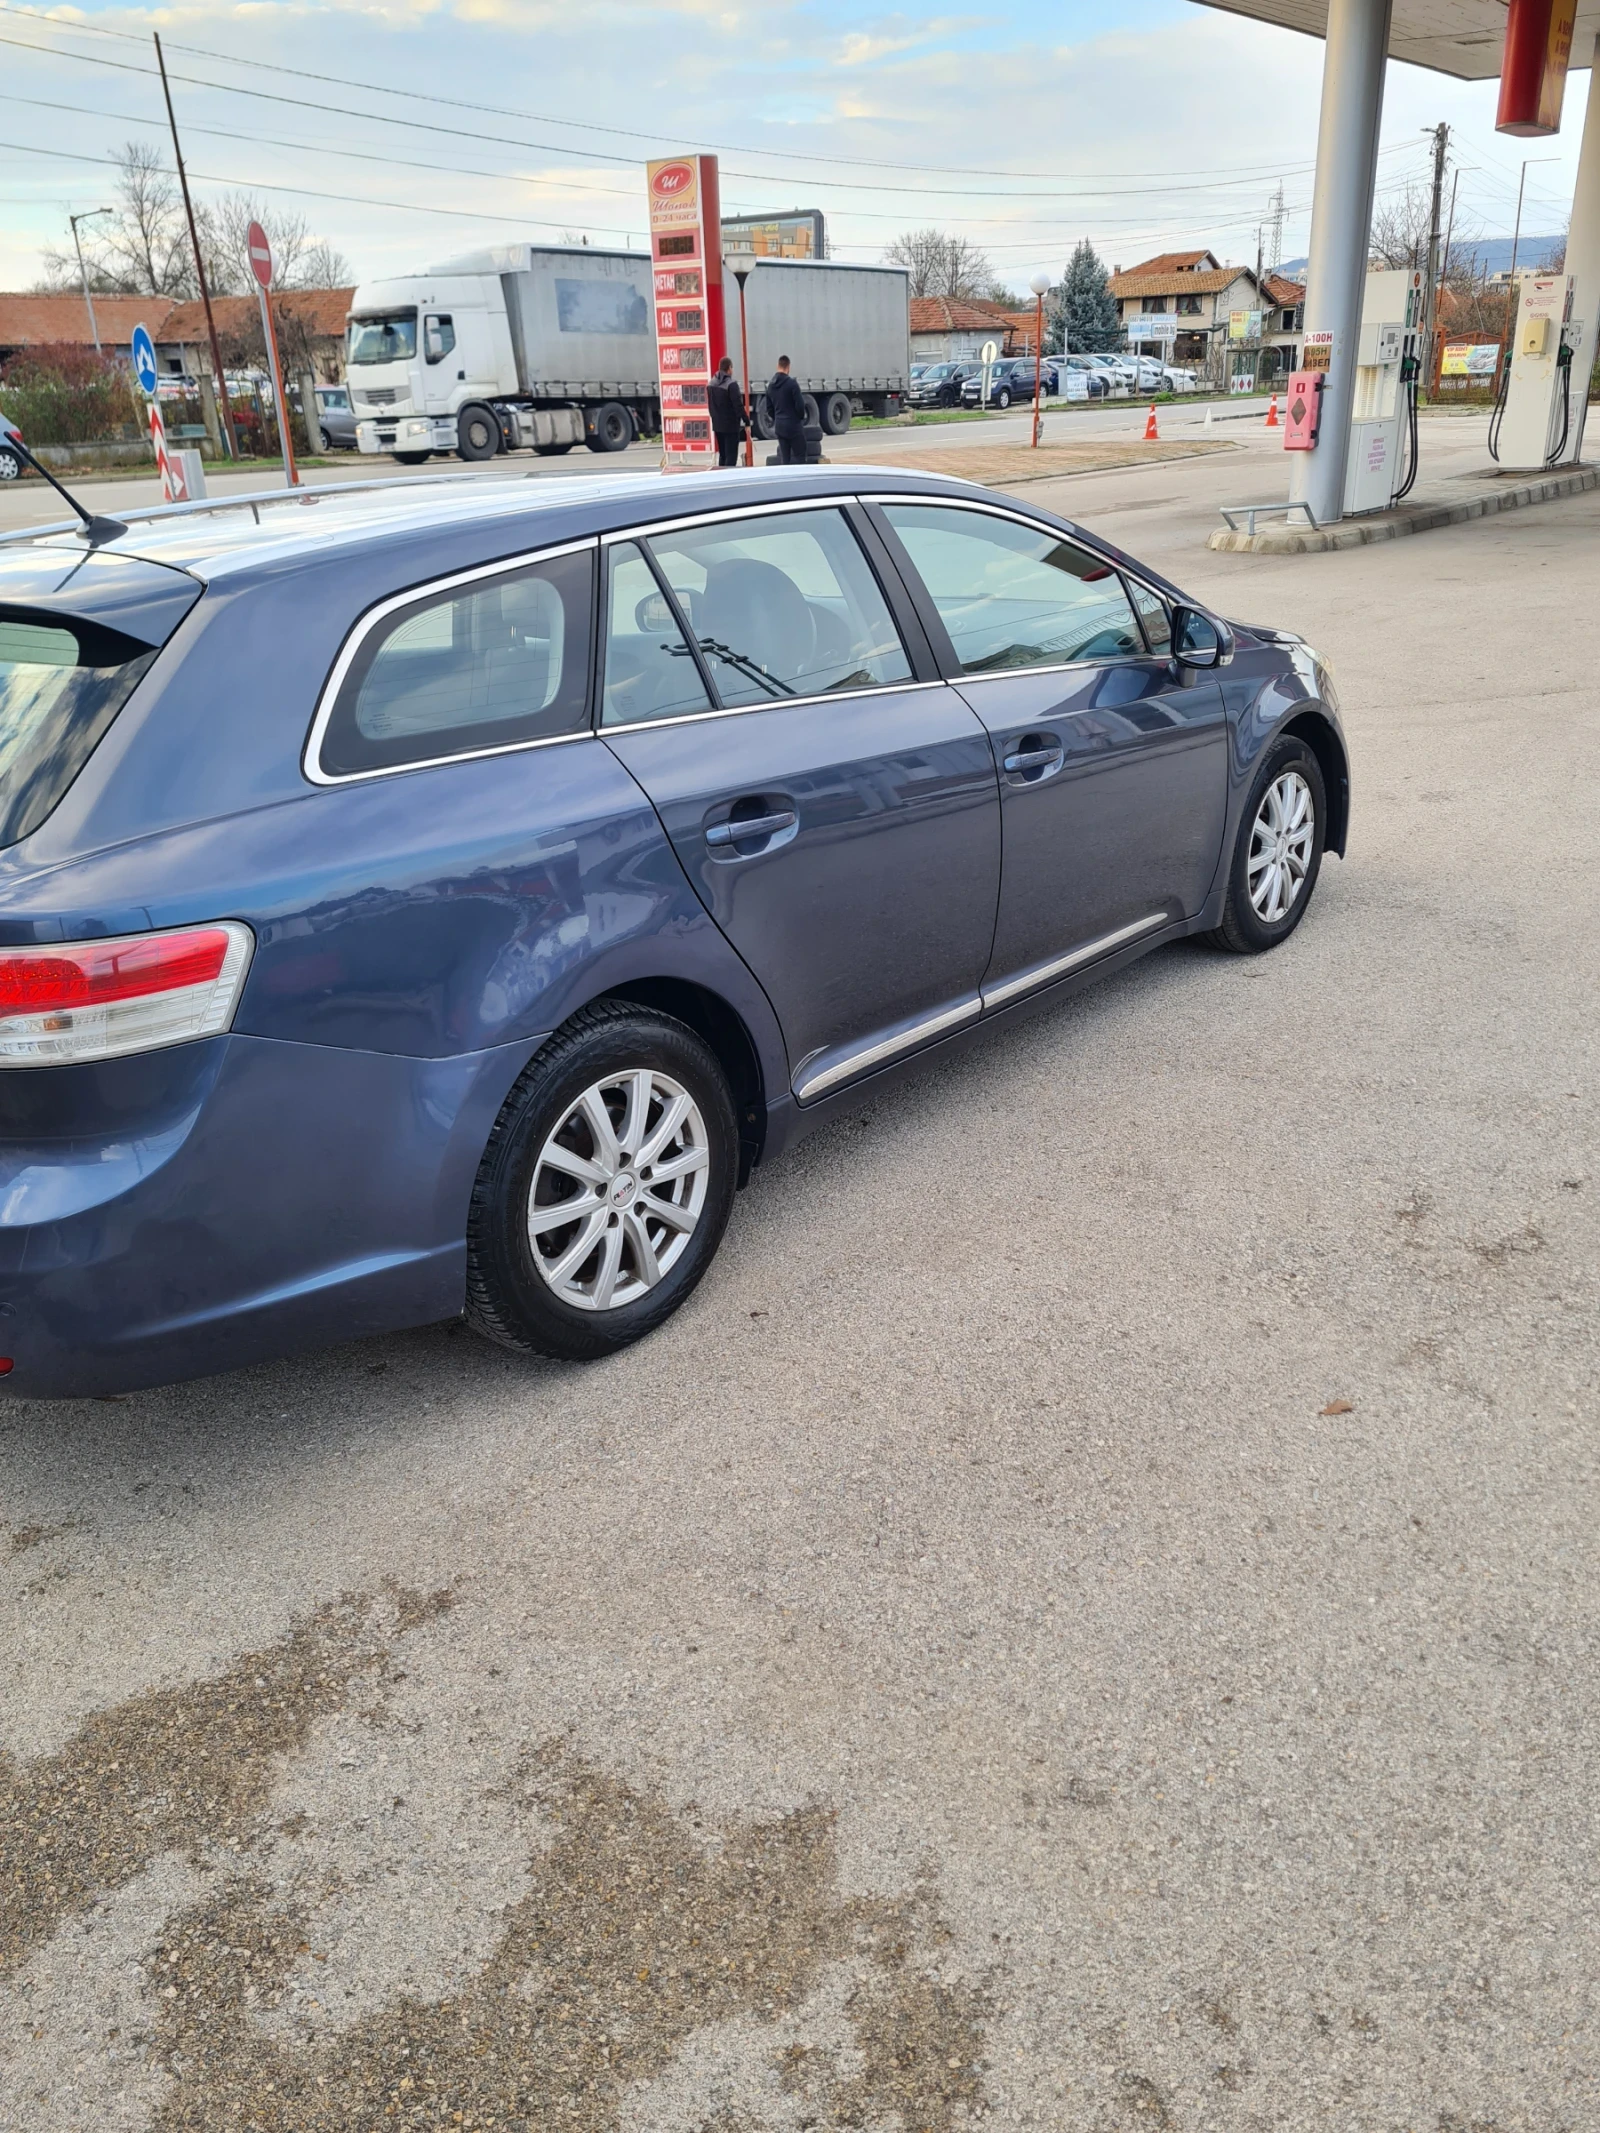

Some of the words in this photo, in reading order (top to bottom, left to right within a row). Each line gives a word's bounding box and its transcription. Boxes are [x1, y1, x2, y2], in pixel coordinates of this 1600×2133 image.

[655, 273, 675, 291] МЕТАН
[661, 311, 673, 328] ГАЗ
[1305, 332, 1333, 343] А-100Н
[662, 384, 683, 403] ДИЗЕЛ
